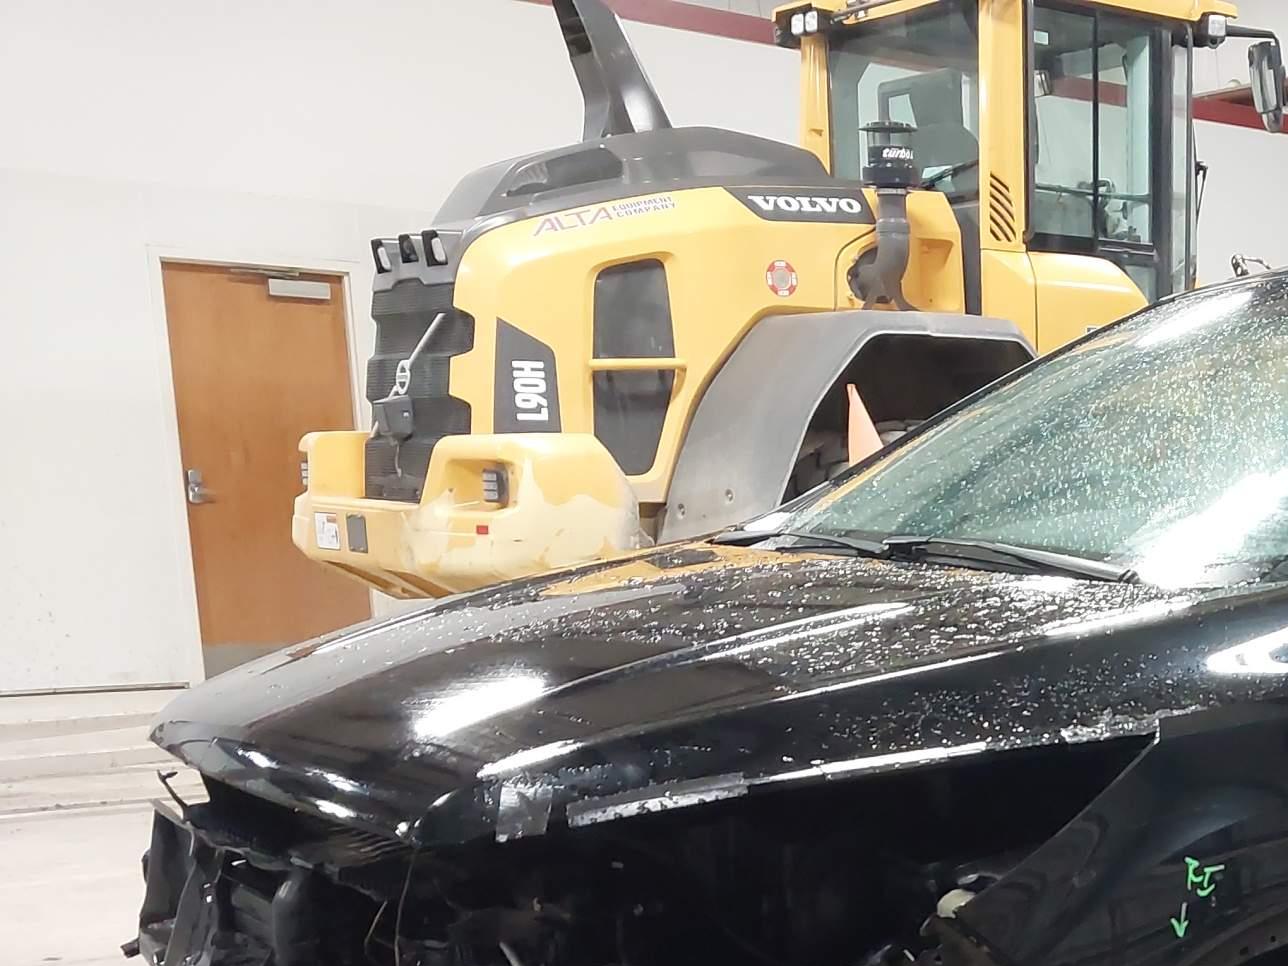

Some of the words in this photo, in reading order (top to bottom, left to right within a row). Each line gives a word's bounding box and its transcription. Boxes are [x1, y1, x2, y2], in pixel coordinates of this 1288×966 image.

[611, 195, 673, 212] EQUIPMENT
[616, 201, 676, 218] COMPANY
[747, 195, 862, 214] VOLVO
[533, 206, 613, 237] ALTA
[511, 360, 549, 421] L90H
